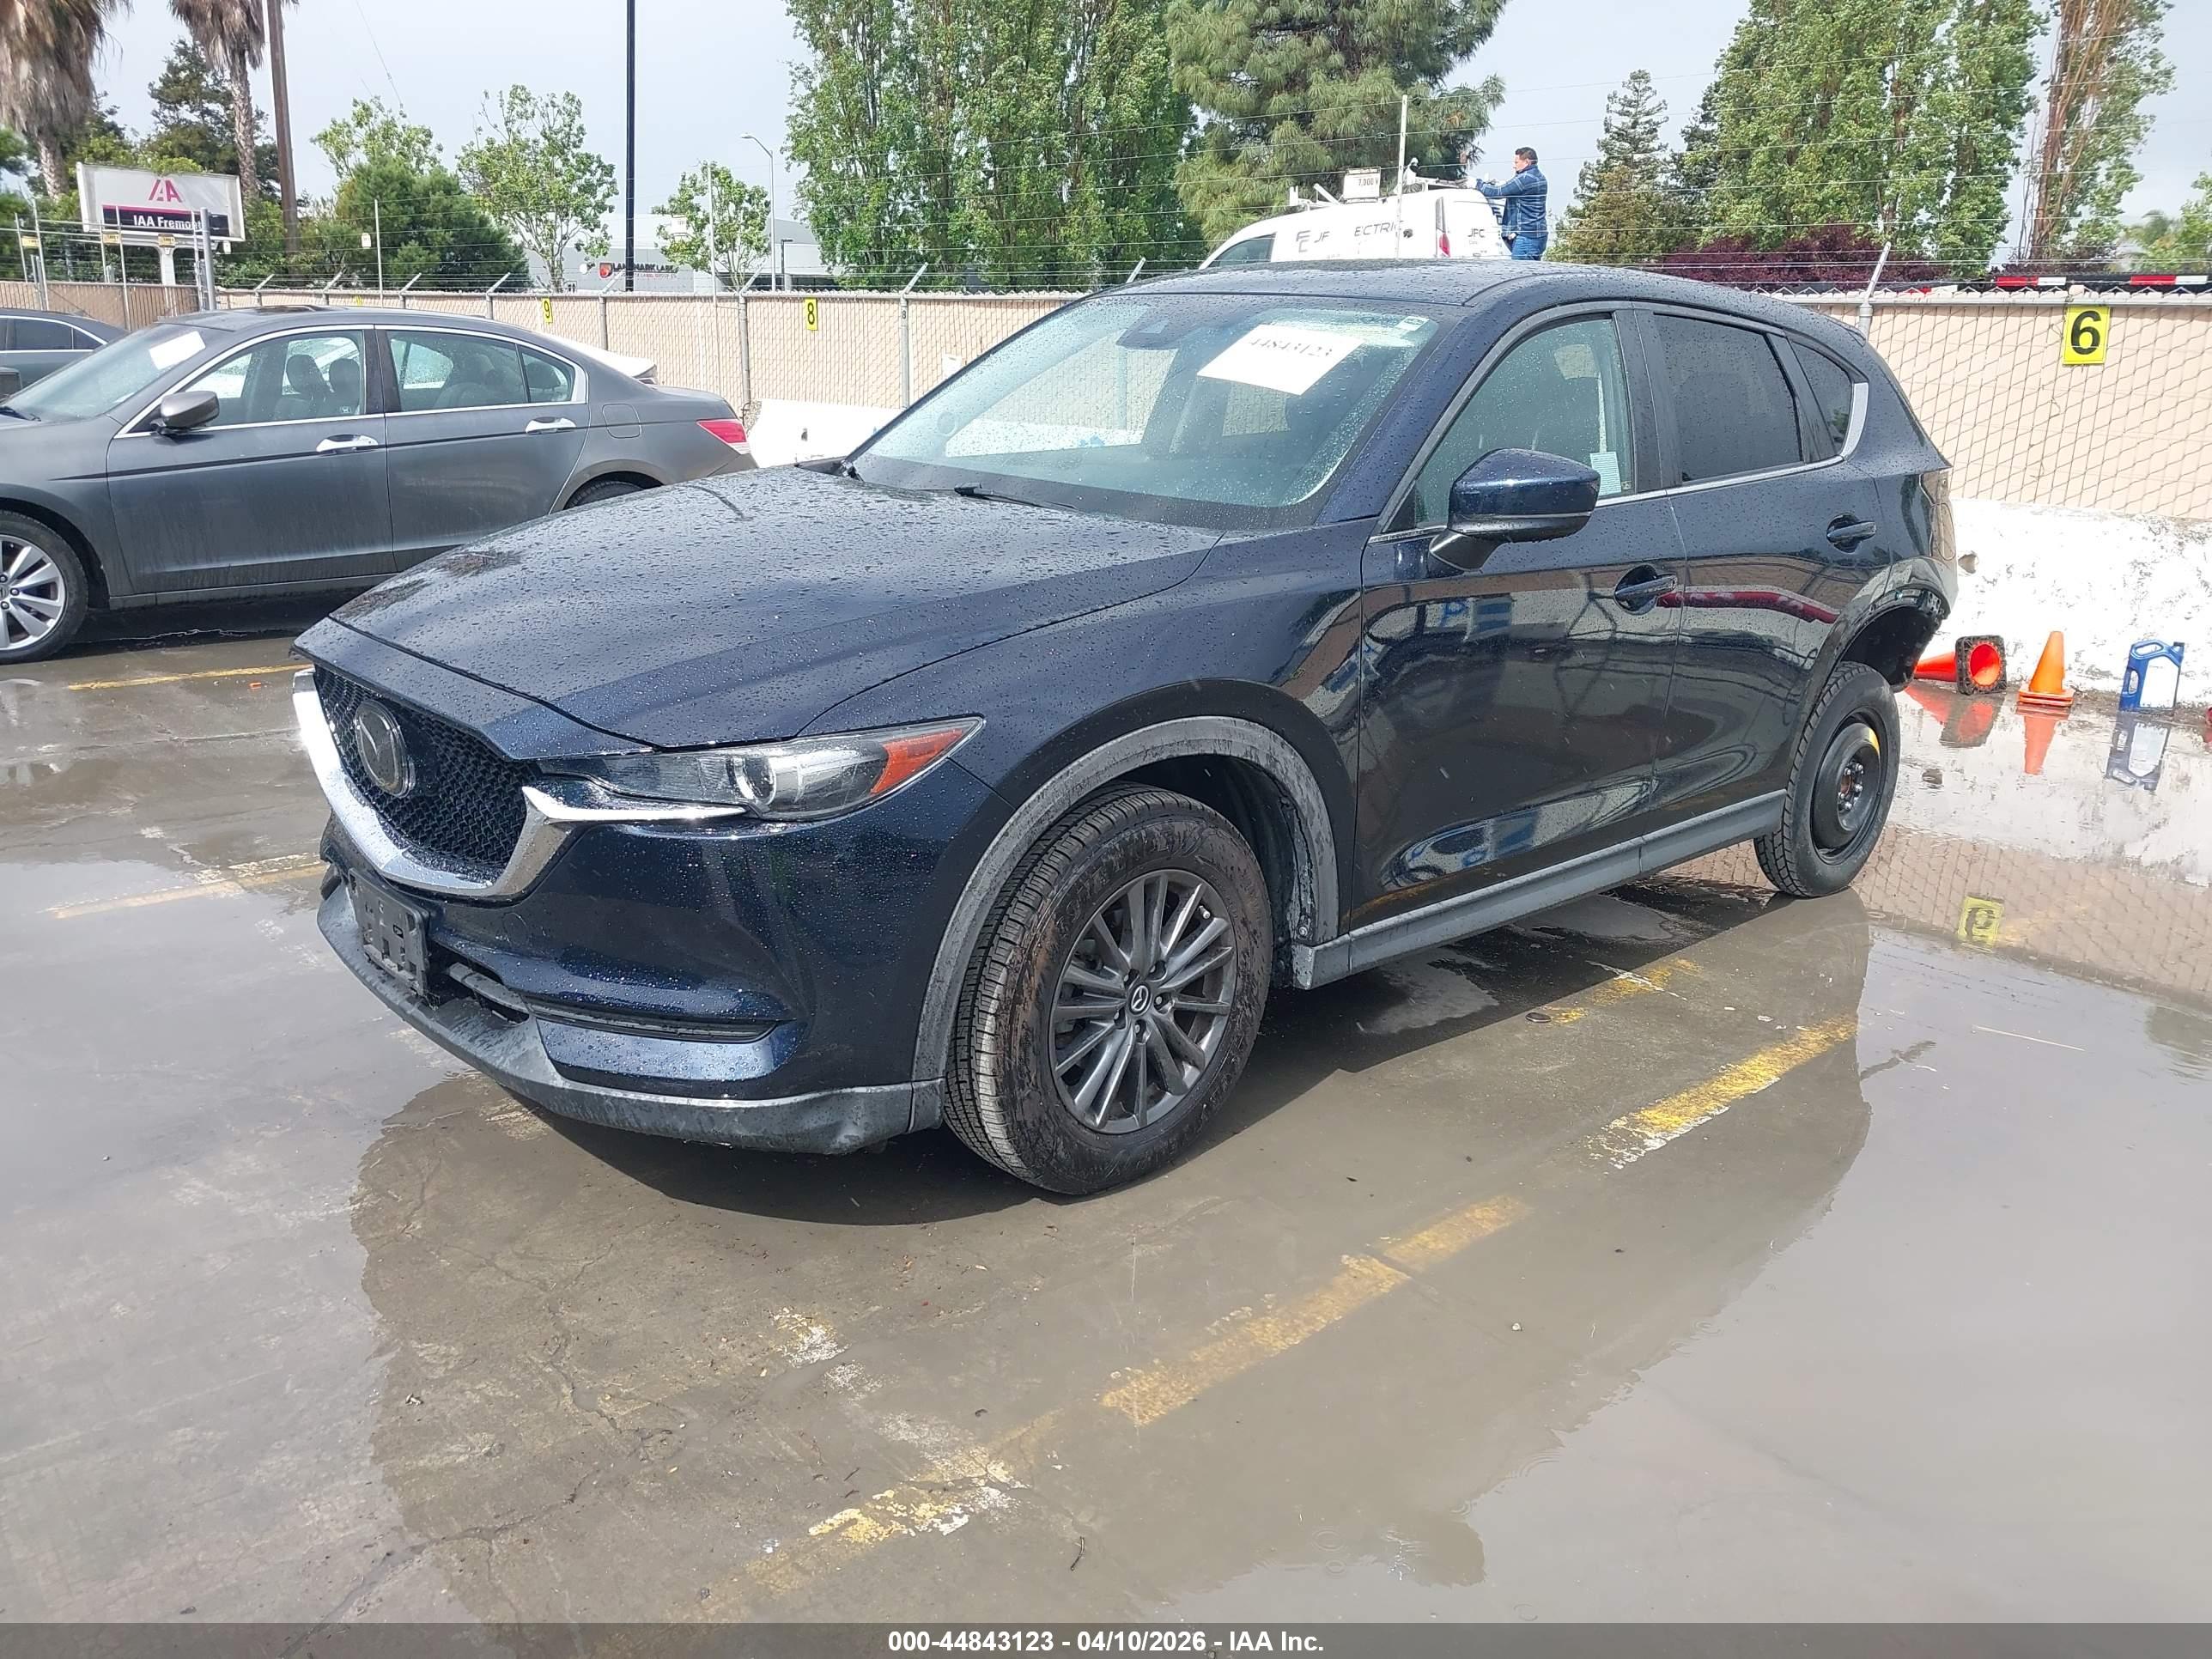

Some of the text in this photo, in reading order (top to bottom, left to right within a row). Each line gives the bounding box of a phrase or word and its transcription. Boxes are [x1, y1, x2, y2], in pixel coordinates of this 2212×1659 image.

[133, 215, 155, 227] IAA
[1468, 228, 1486, 238] JFC
[544, 301, 550, 319] 9
[807, 302, 816, 325] 8
[902, 310, 907, 319] 8
[2070, 310, 2101, 356] 6
